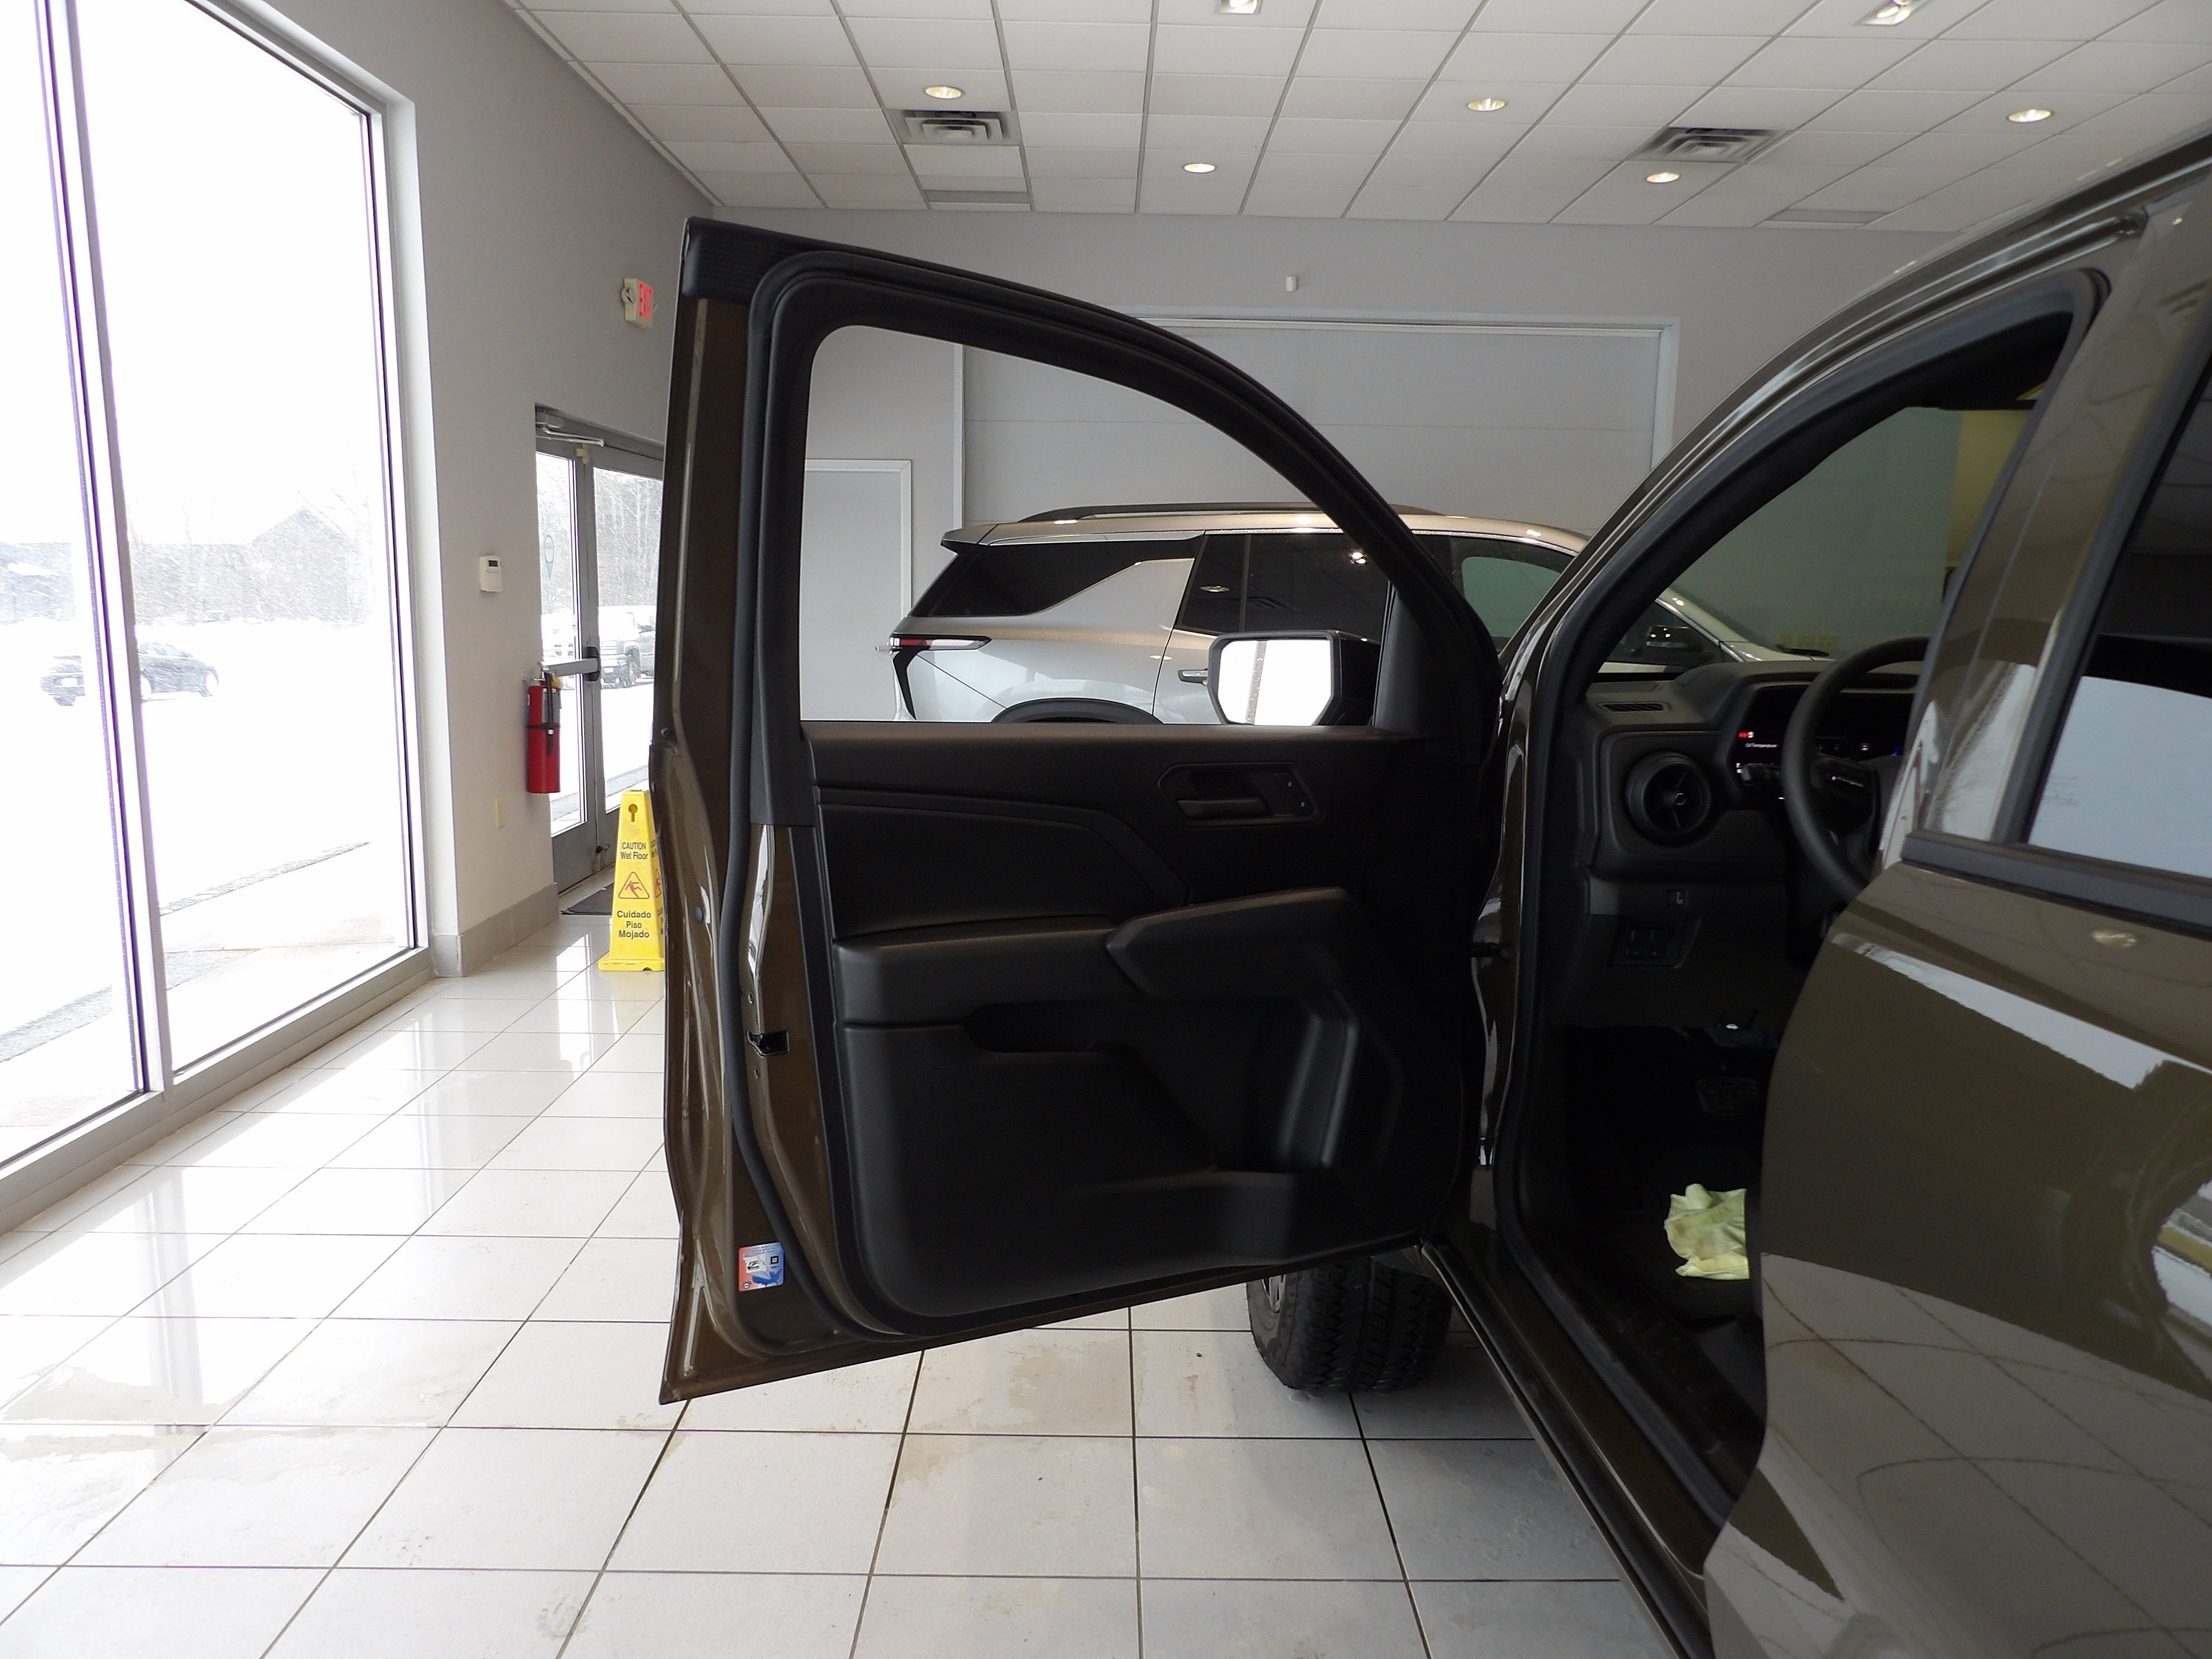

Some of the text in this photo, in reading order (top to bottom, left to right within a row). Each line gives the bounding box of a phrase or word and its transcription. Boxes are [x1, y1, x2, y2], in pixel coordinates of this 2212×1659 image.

[620, 851, 632, 859] Wet
[633, 852, 649, 860] Floor
[617, 910, 651, 918] Cuidado
[618, 930, 649, 939] Mojado
